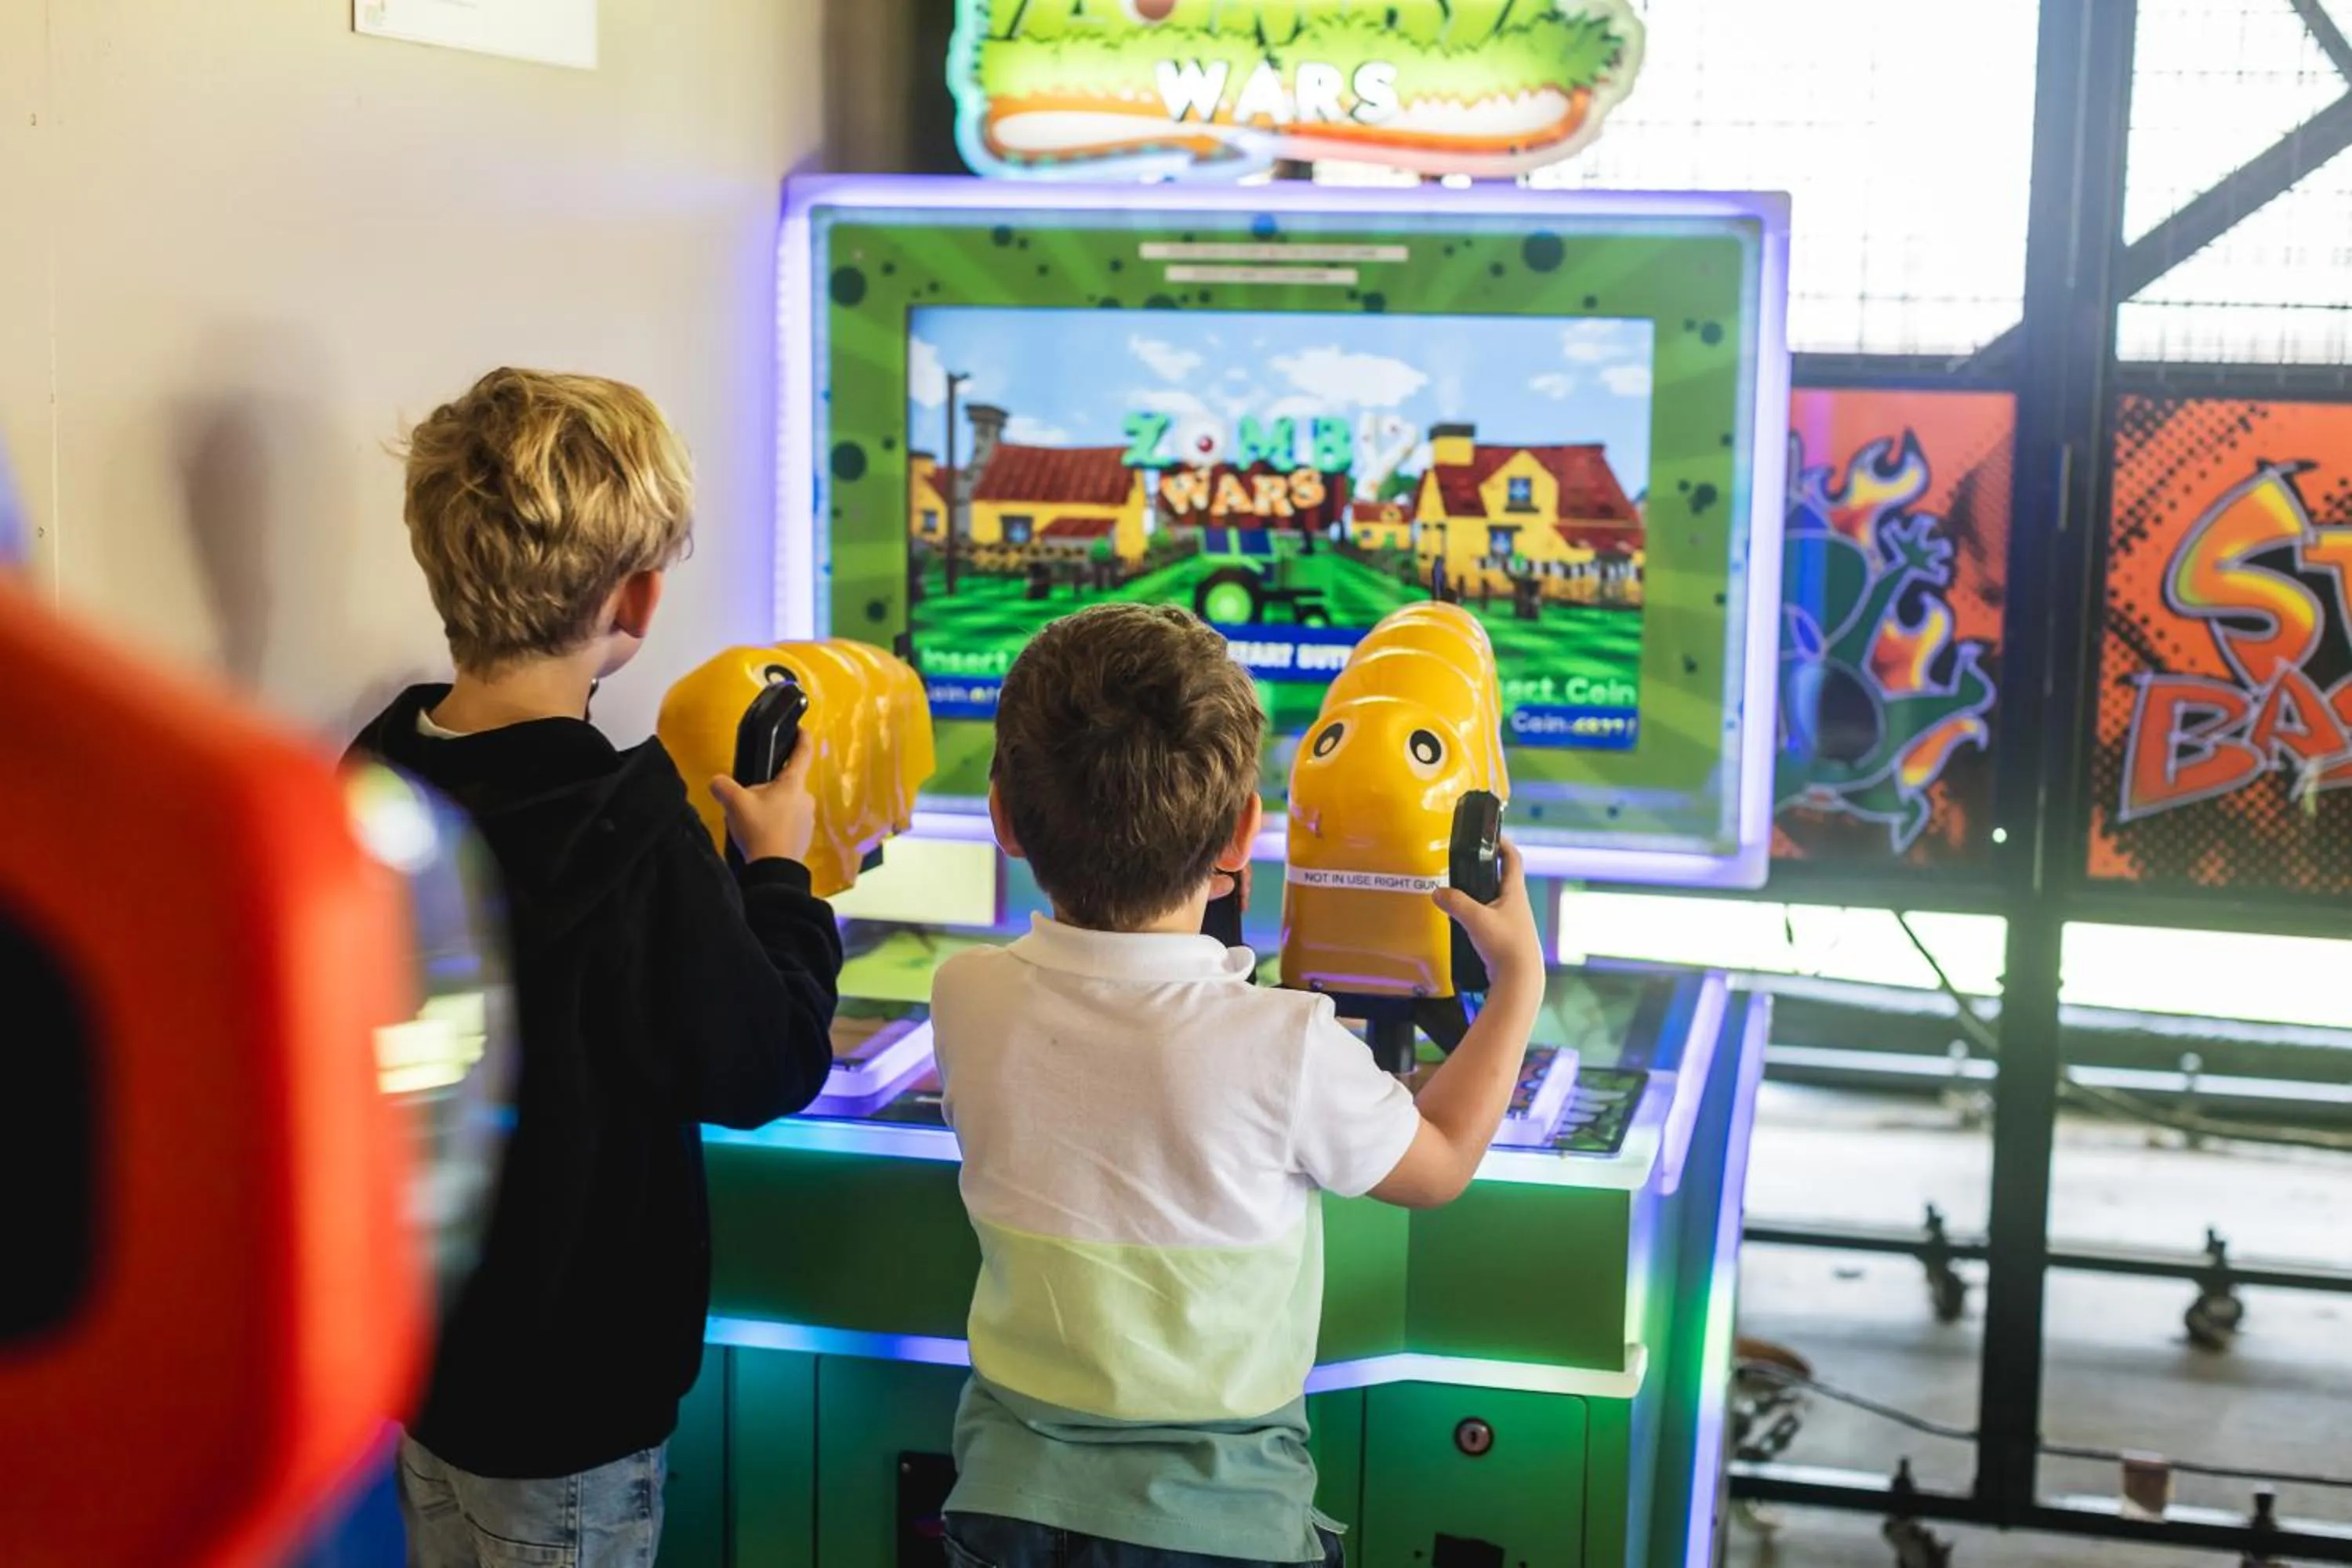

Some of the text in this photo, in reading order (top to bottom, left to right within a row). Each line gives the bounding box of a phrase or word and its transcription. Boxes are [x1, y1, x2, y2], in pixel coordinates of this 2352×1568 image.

[1155, 59, 1399, 125] WARS
[1160, 466, 1327, 517] WARS
[1566, 677, 1637, 705] Coin
[1305, 872, 1440, 890] NOT IN USE RIGHT GUN
